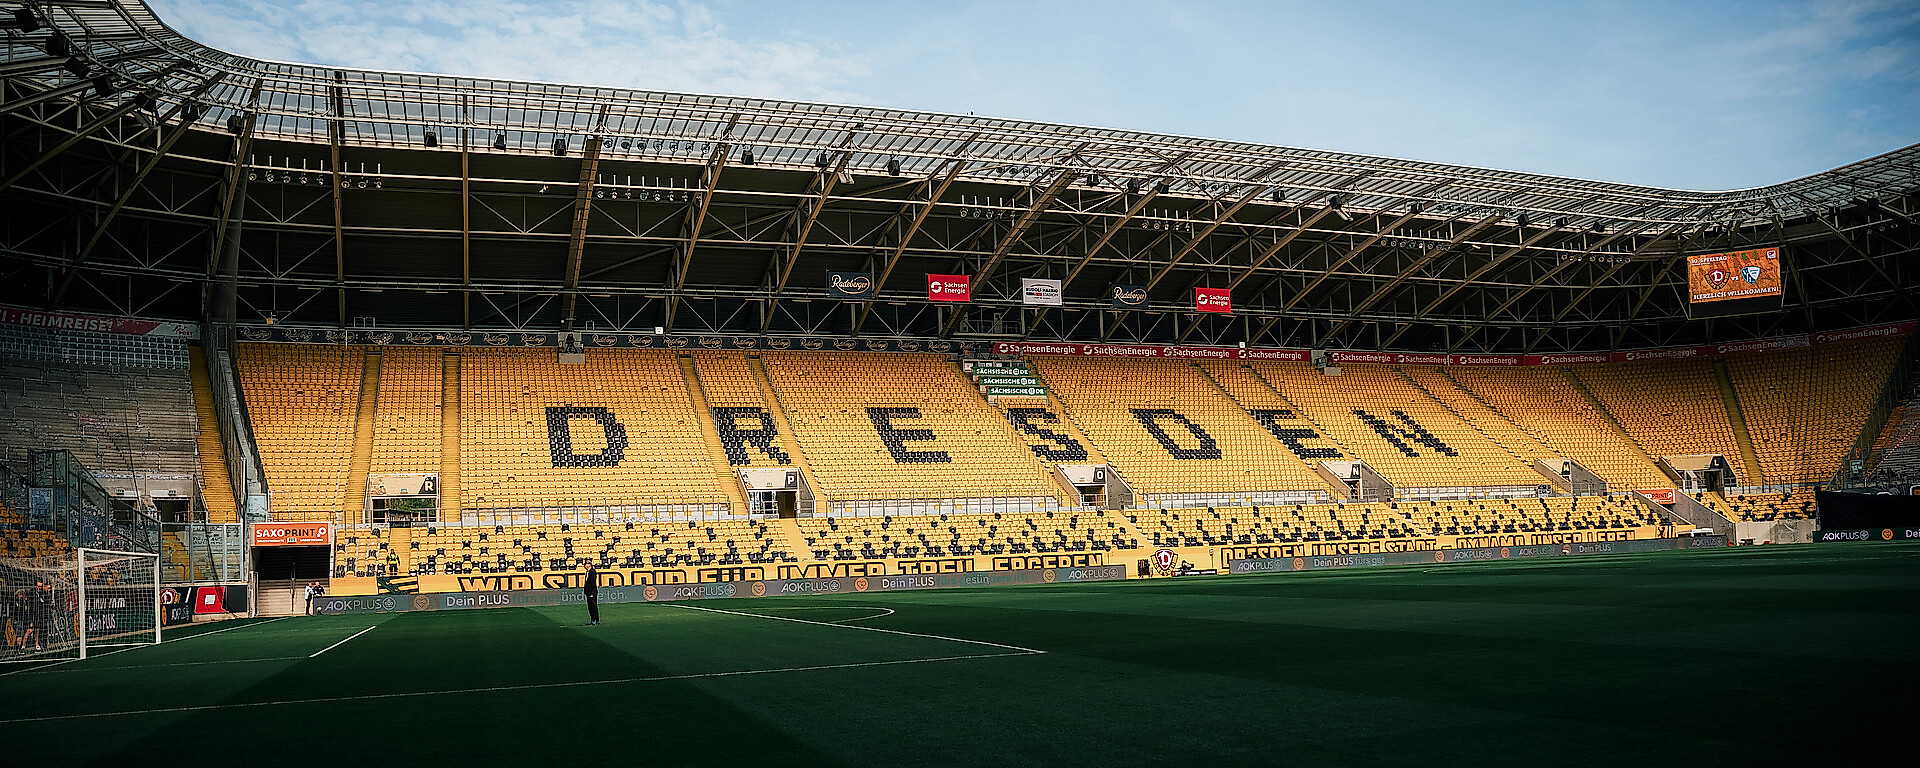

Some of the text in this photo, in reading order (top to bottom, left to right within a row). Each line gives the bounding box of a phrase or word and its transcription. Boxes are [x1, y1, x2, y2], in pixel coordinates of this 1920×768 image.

[831, 274, 870, 294] Radeberger
[944, 281, 968, 289] Sachsen
[1113, 286, 1147, 305] Radeberger
[1693, 286, 1779, 300] HERZLICH WILLKOMMEN!
[19, 311, 113, 332] HEIMREISE!
[1827, 326, 1897, 342] SachsenEnergie
[1010, 344, 1075, 354] SachsenEnergie
[1249, 350, 1301, 360] SachsenEnergie
[1340, 353, 1391, 362] SachsenEnergie
[1405, 355, 1453, 364] SachsenEnerge
[1551, 354, 1607, 364] SachsenEnergie
[1468, 356, 1517, 365] SachsenEnergie
[545, 406, 1459, 467] DRESDEN
[1713, 459, 1720, 467] L
[1352, 466, 1360, 476] N
[787, 475, 795, 485] P
[424, 480, 434, 491] R
[256, 528, 315, 538] SAXOPRINT
[1314, 558, 1333, 567] Dein
[1333, 556, 1354, 566] PLUS
[1579, 544, 1594, 553] Dein
[1595, 543, 1612, 552] PLUS
[446, 595, 475, 607] Dein
[478, 594, 510, 606] PLUS
[882, 578, 906, 589] Dein
[908, 576, 935, 588] PLUS
